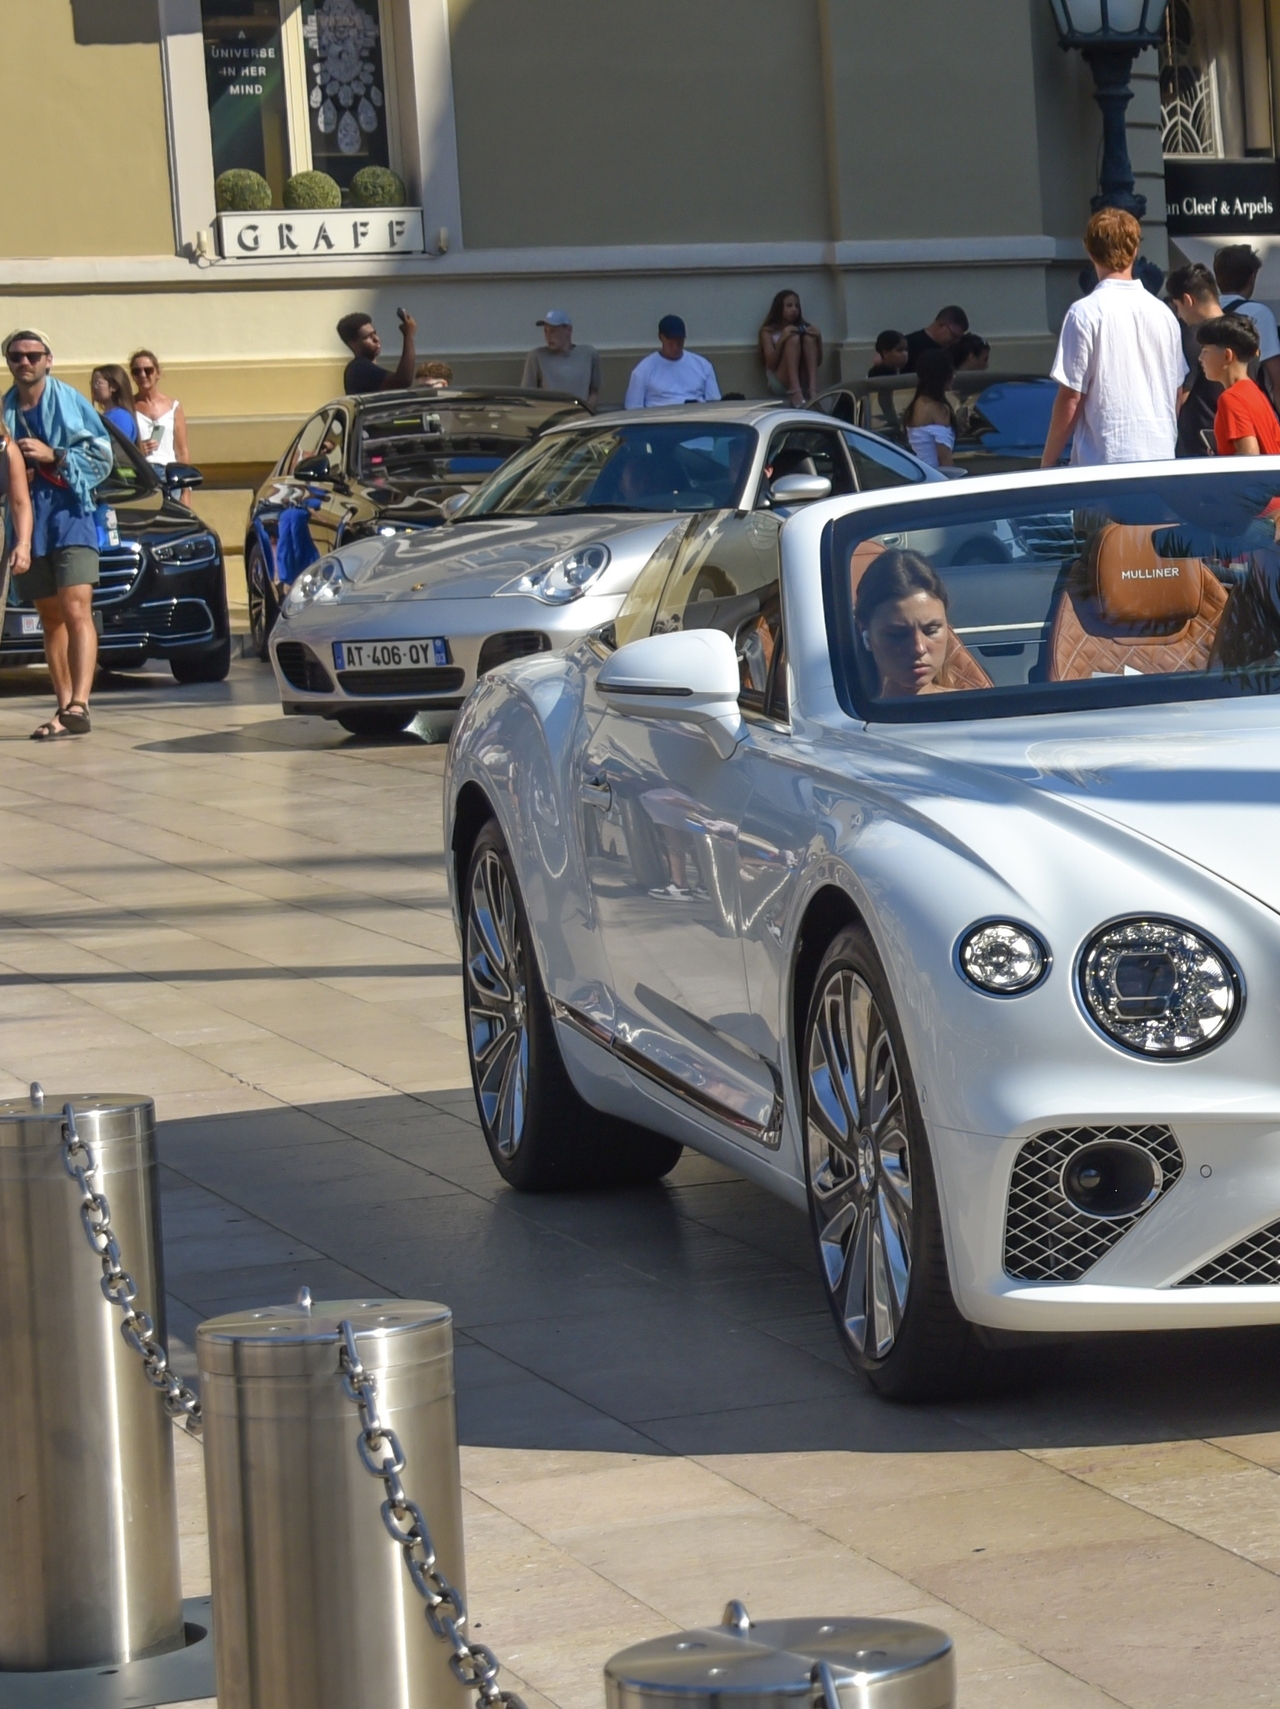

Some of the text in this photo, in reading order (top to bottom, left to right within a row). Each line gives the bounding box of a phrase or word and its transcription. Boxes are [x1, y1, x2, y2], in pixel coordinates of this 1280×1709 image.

[237, 29, 246, 40] A
[211, 46, 276, 59] UNIVERSE
[222, 65, 267, 77] IN HER
[229, 84, 263, 95] MIND
[1182, 196, 1218, 215] Cleef
[1220, 200, 1231, 215] &
[1233, 195, 1274, 220] Arpels
[236, 219, 407, 252] GRAFF
[1121, 567, 1180, 580] MULLINER
